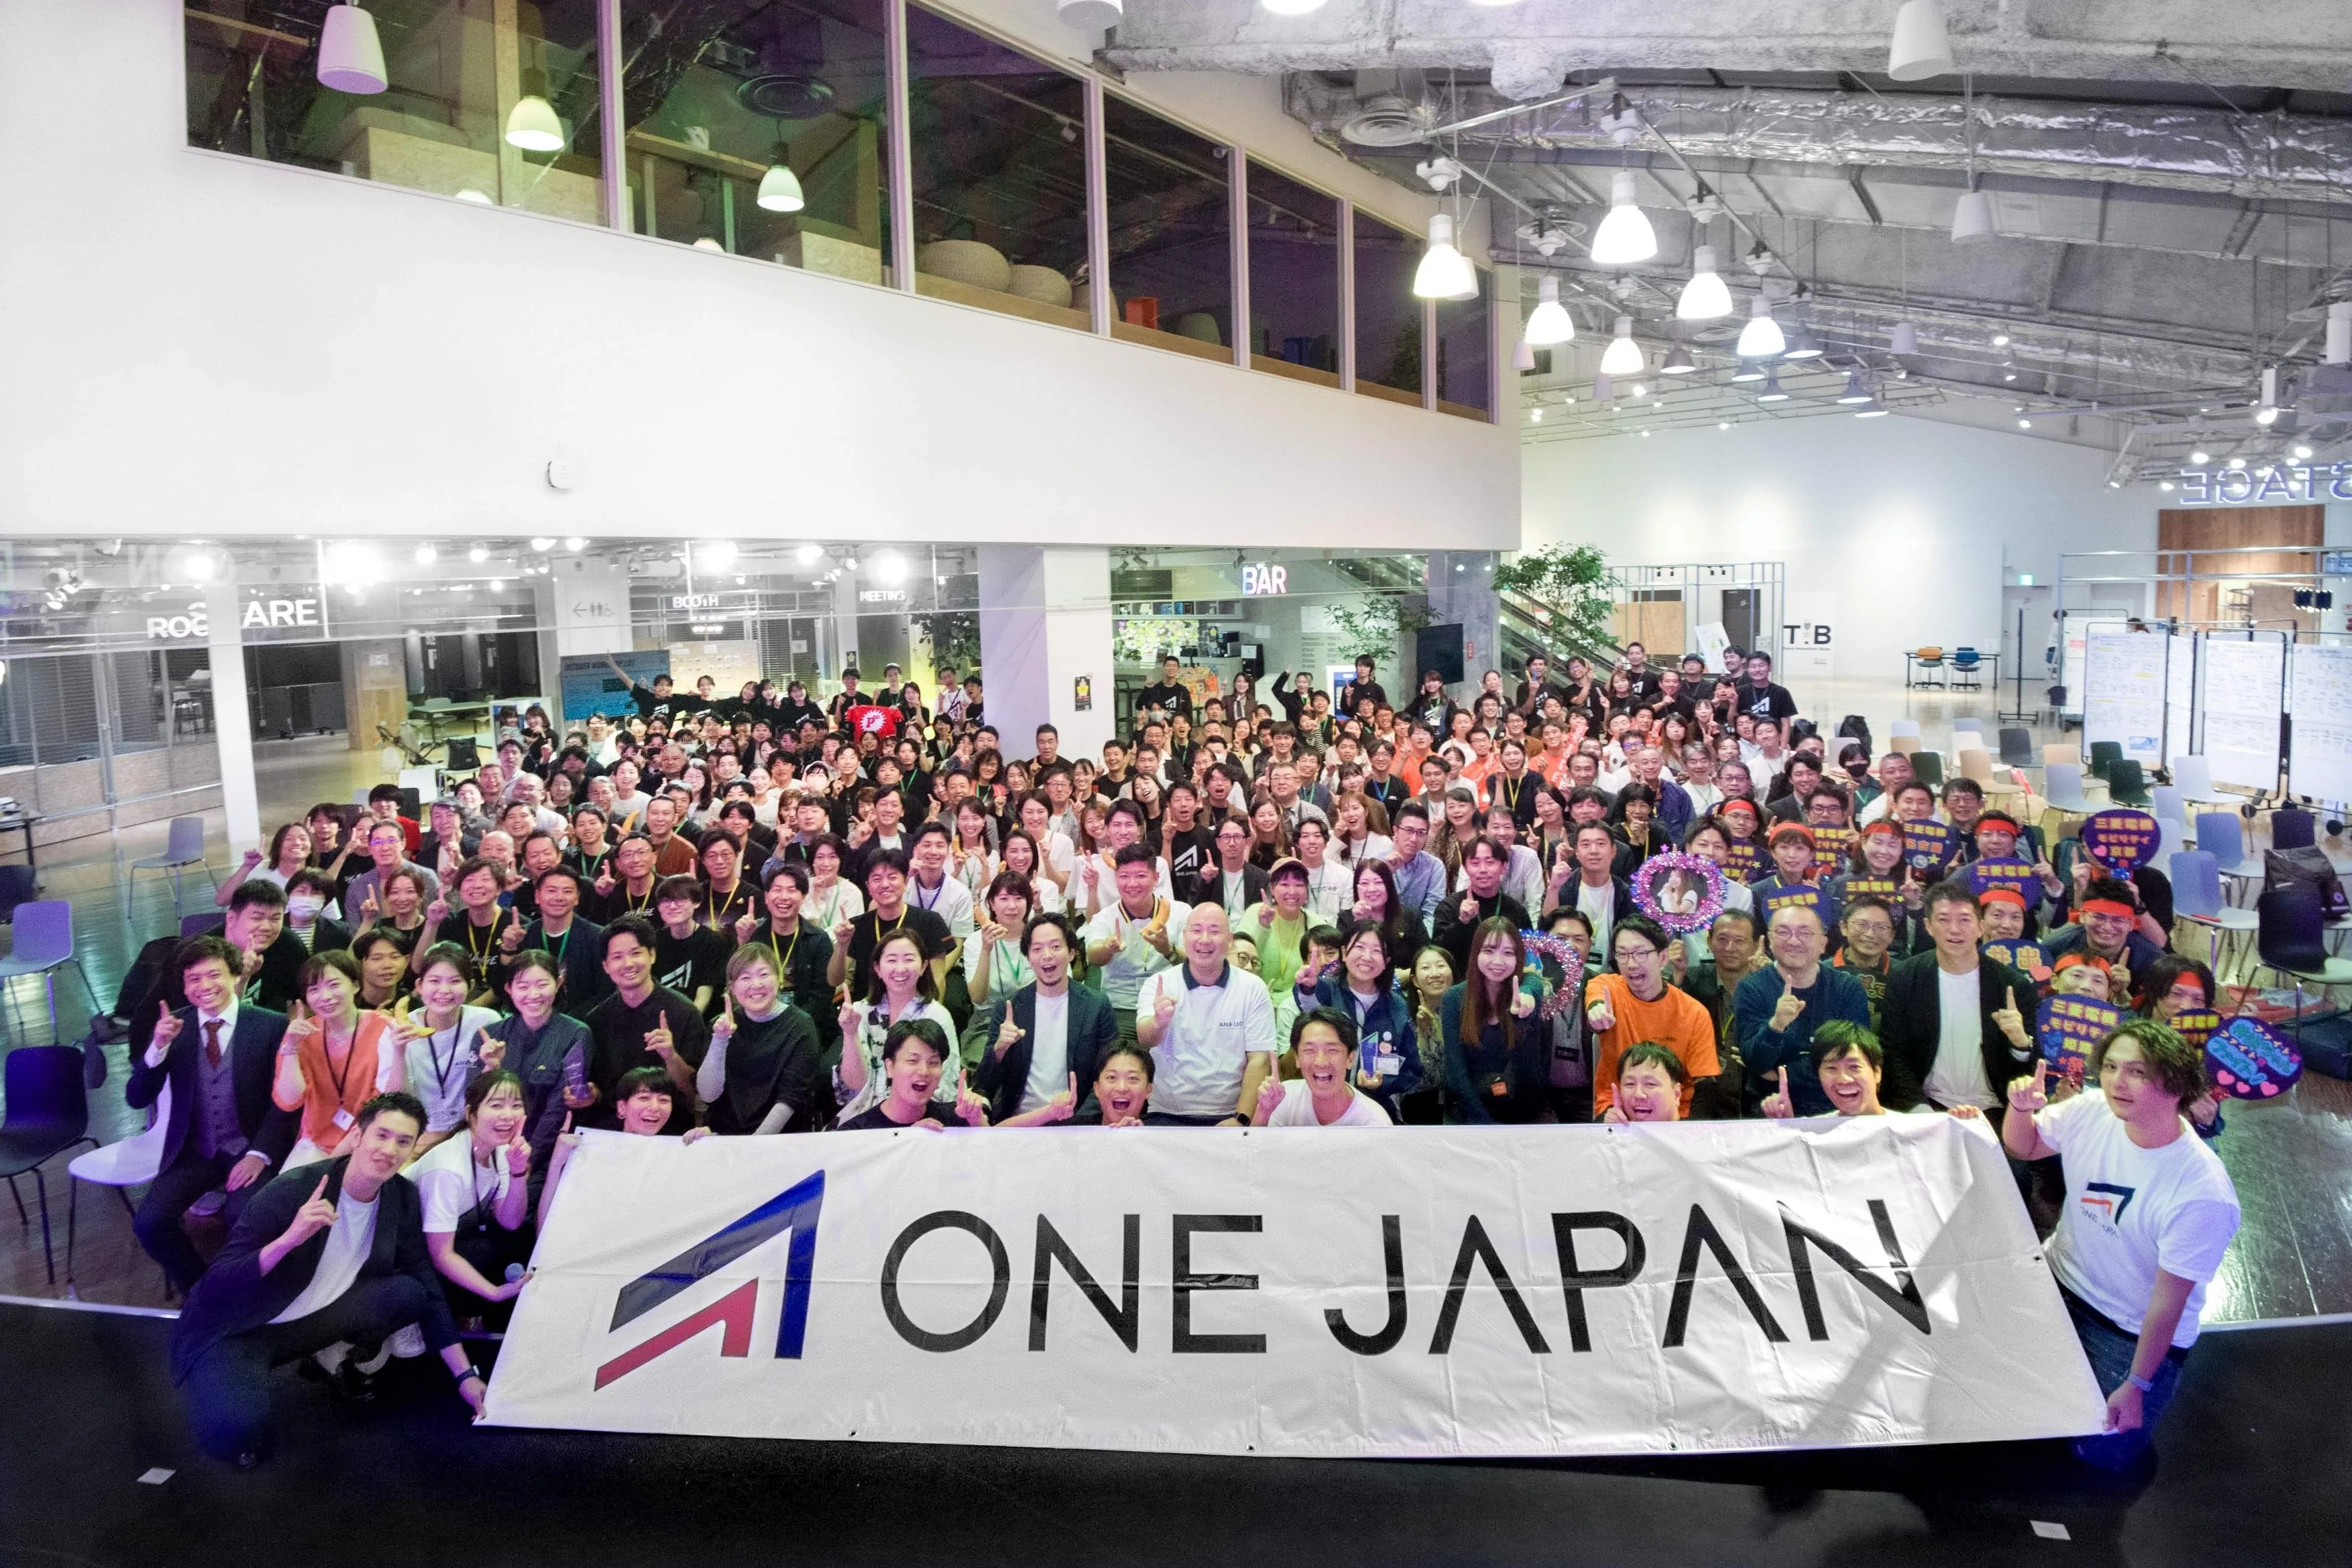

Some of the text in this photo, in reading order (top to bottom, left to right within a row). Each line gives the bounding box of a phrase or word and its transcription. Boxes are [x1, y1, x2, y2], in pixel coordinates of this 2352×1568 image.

[1242, 565, 1287, 595] BAR
[672, 595, 719, 609] BOOTH
[859, 590, 906, 602] MEETING
[881, 1199, 1931, 1355] ONE JAPAN
